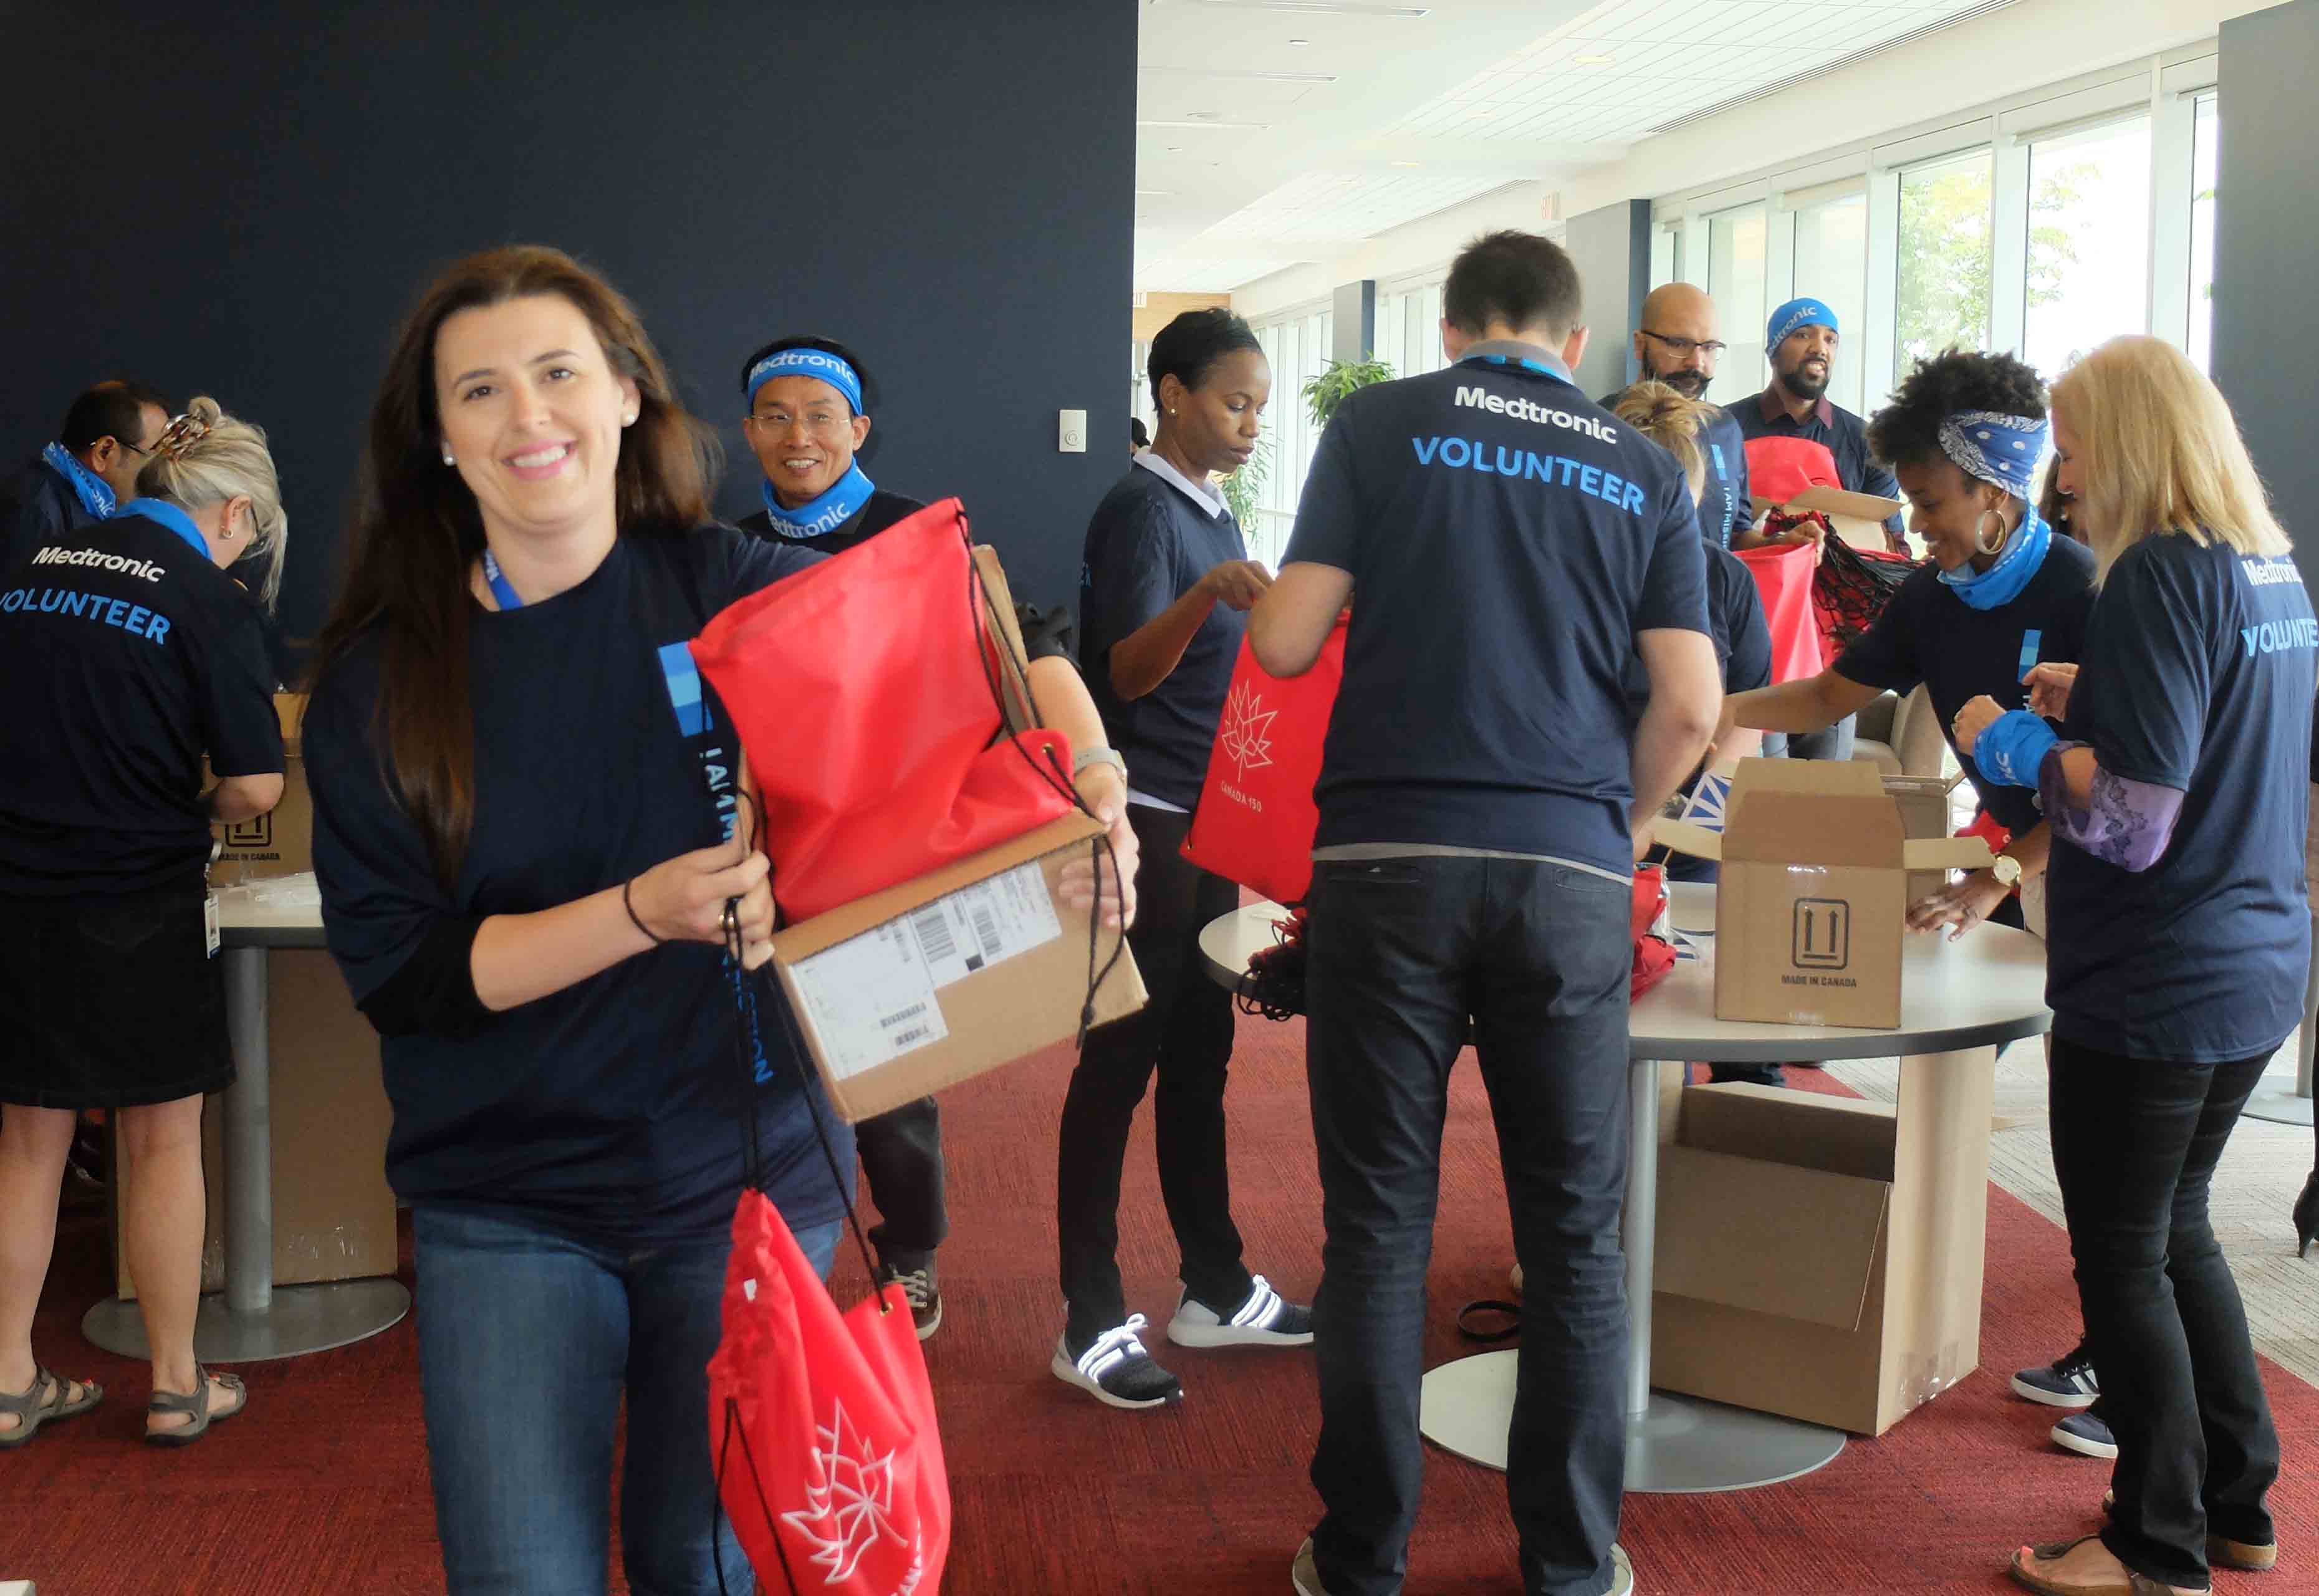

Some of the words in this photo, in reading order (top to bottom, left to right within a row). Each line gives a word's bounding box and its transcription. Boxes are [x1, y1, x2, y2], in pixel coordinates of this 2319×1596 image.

[1454, 386, 1617, 445] Medtronic
[1411, 436, 1646, 516] VOLUNTEER
[32, 546, 166, 582] Medtronic
[1221, 781, 1247, 804] CANADA
[1249, 797, 1262, 812] 150
[1781, 974, 1806, 984] MADE
[1810, 976, 1818, 985] IN
[1820, 977, 1856, 988] CANADA
